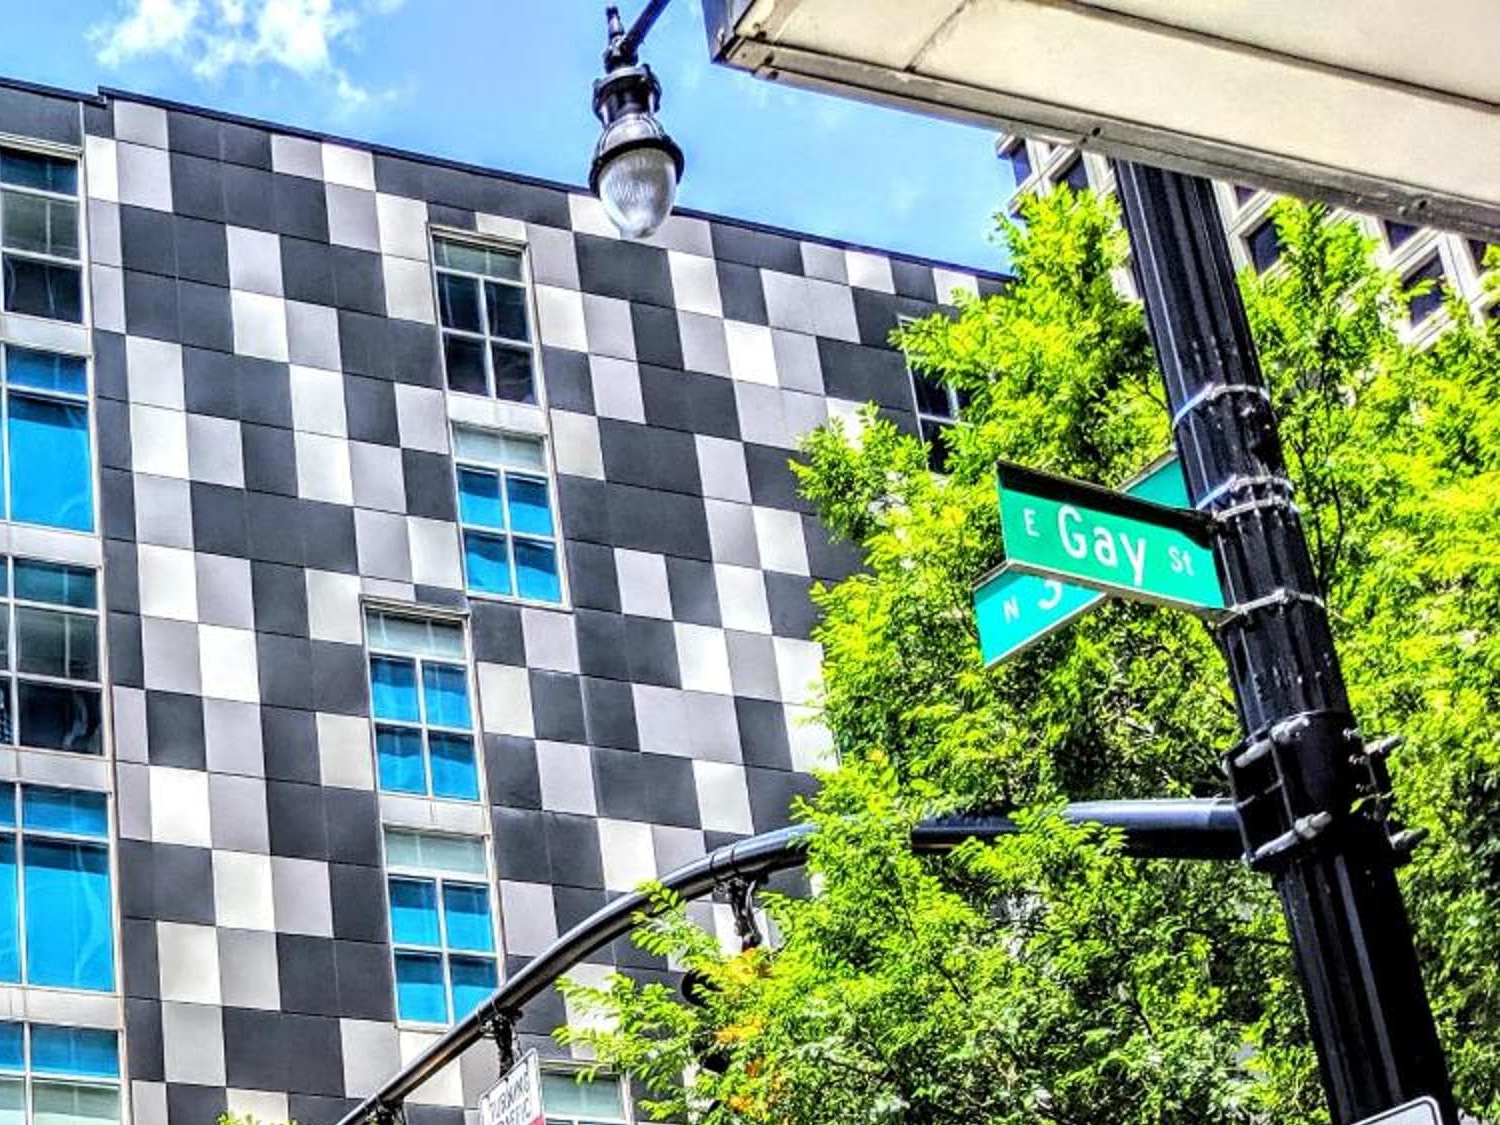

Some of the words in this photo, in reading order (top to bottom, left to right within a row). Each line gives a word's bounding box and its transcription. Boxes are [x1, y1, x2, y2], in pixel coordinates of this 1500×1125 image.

[1022, 507, 1041, 538] E
[1058, 504, 1146, 587] Gay
[1168, 545, 1195, 577] St
[1003, 596, 1020, 624] N
[489, 1070, 532, 1125] TURNING
